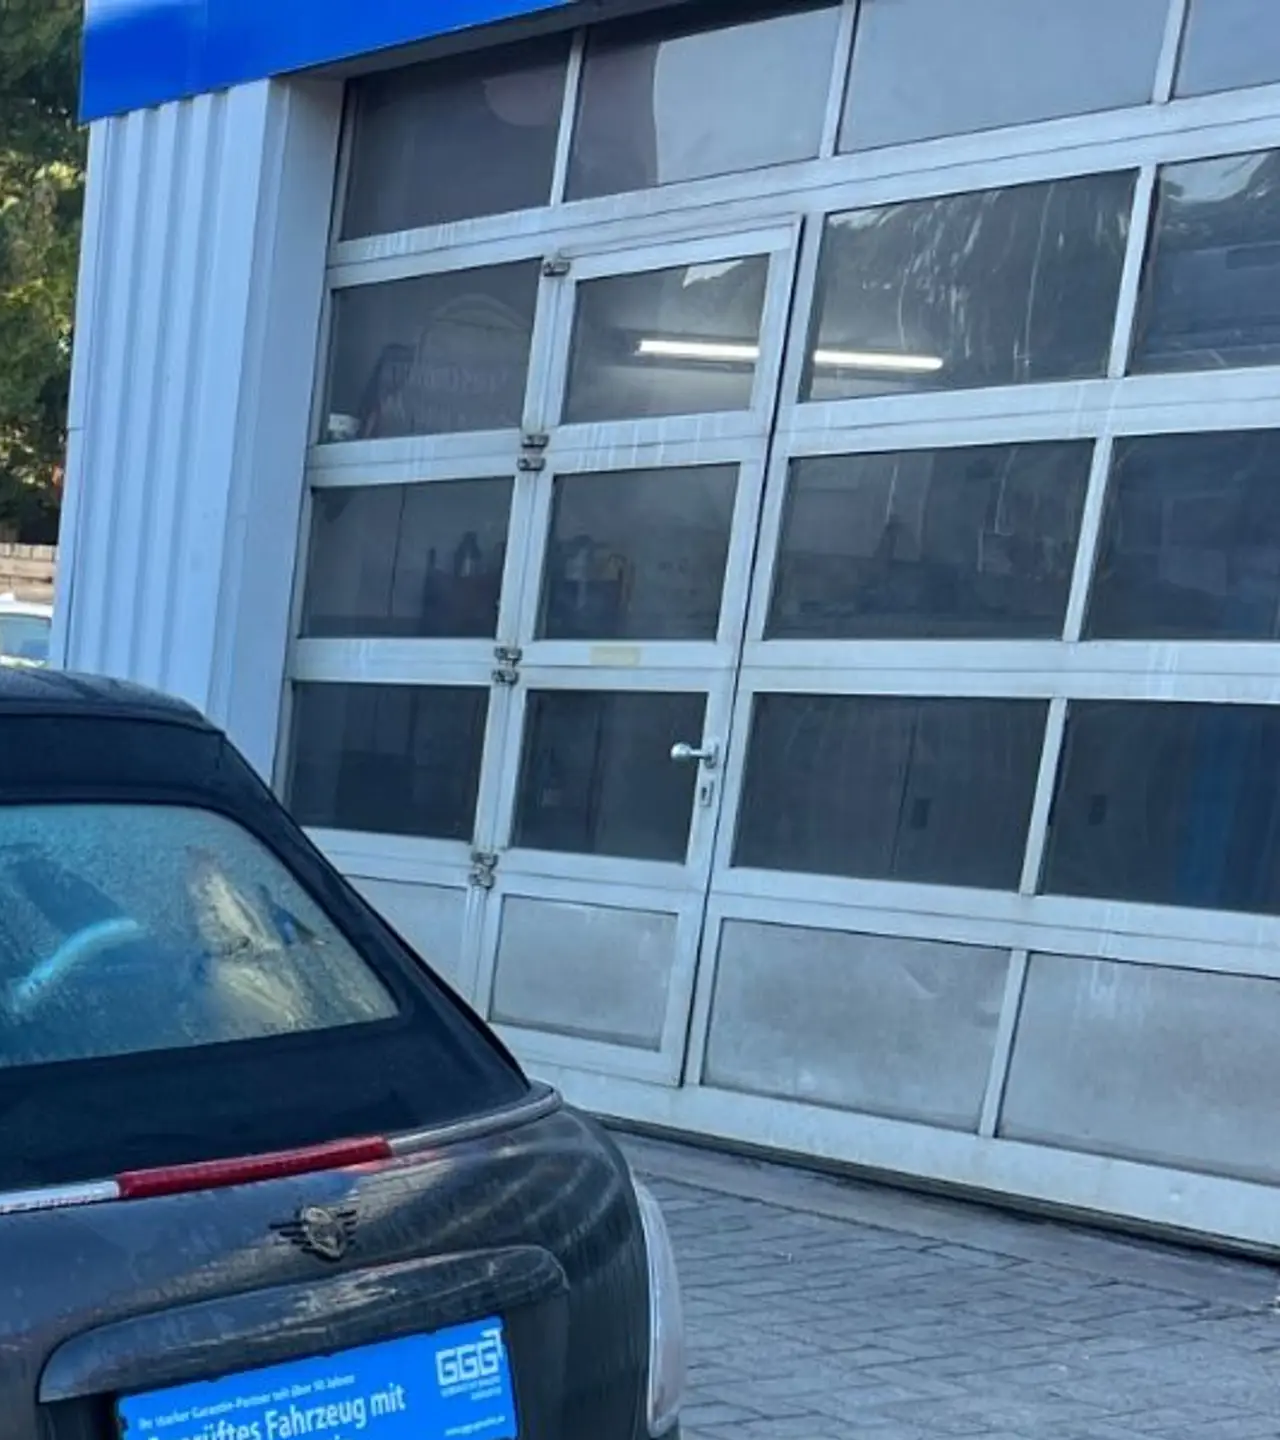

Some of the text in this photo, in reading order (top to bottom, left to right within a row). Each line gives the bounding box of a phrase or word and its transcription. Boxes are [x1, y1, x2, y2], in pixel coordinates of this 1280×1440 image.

[435, 1334, 501, 1386] GGG
[264, 1397, 367, 1440] Fahrzeug
[370, 1382, 406, 1416] mit
